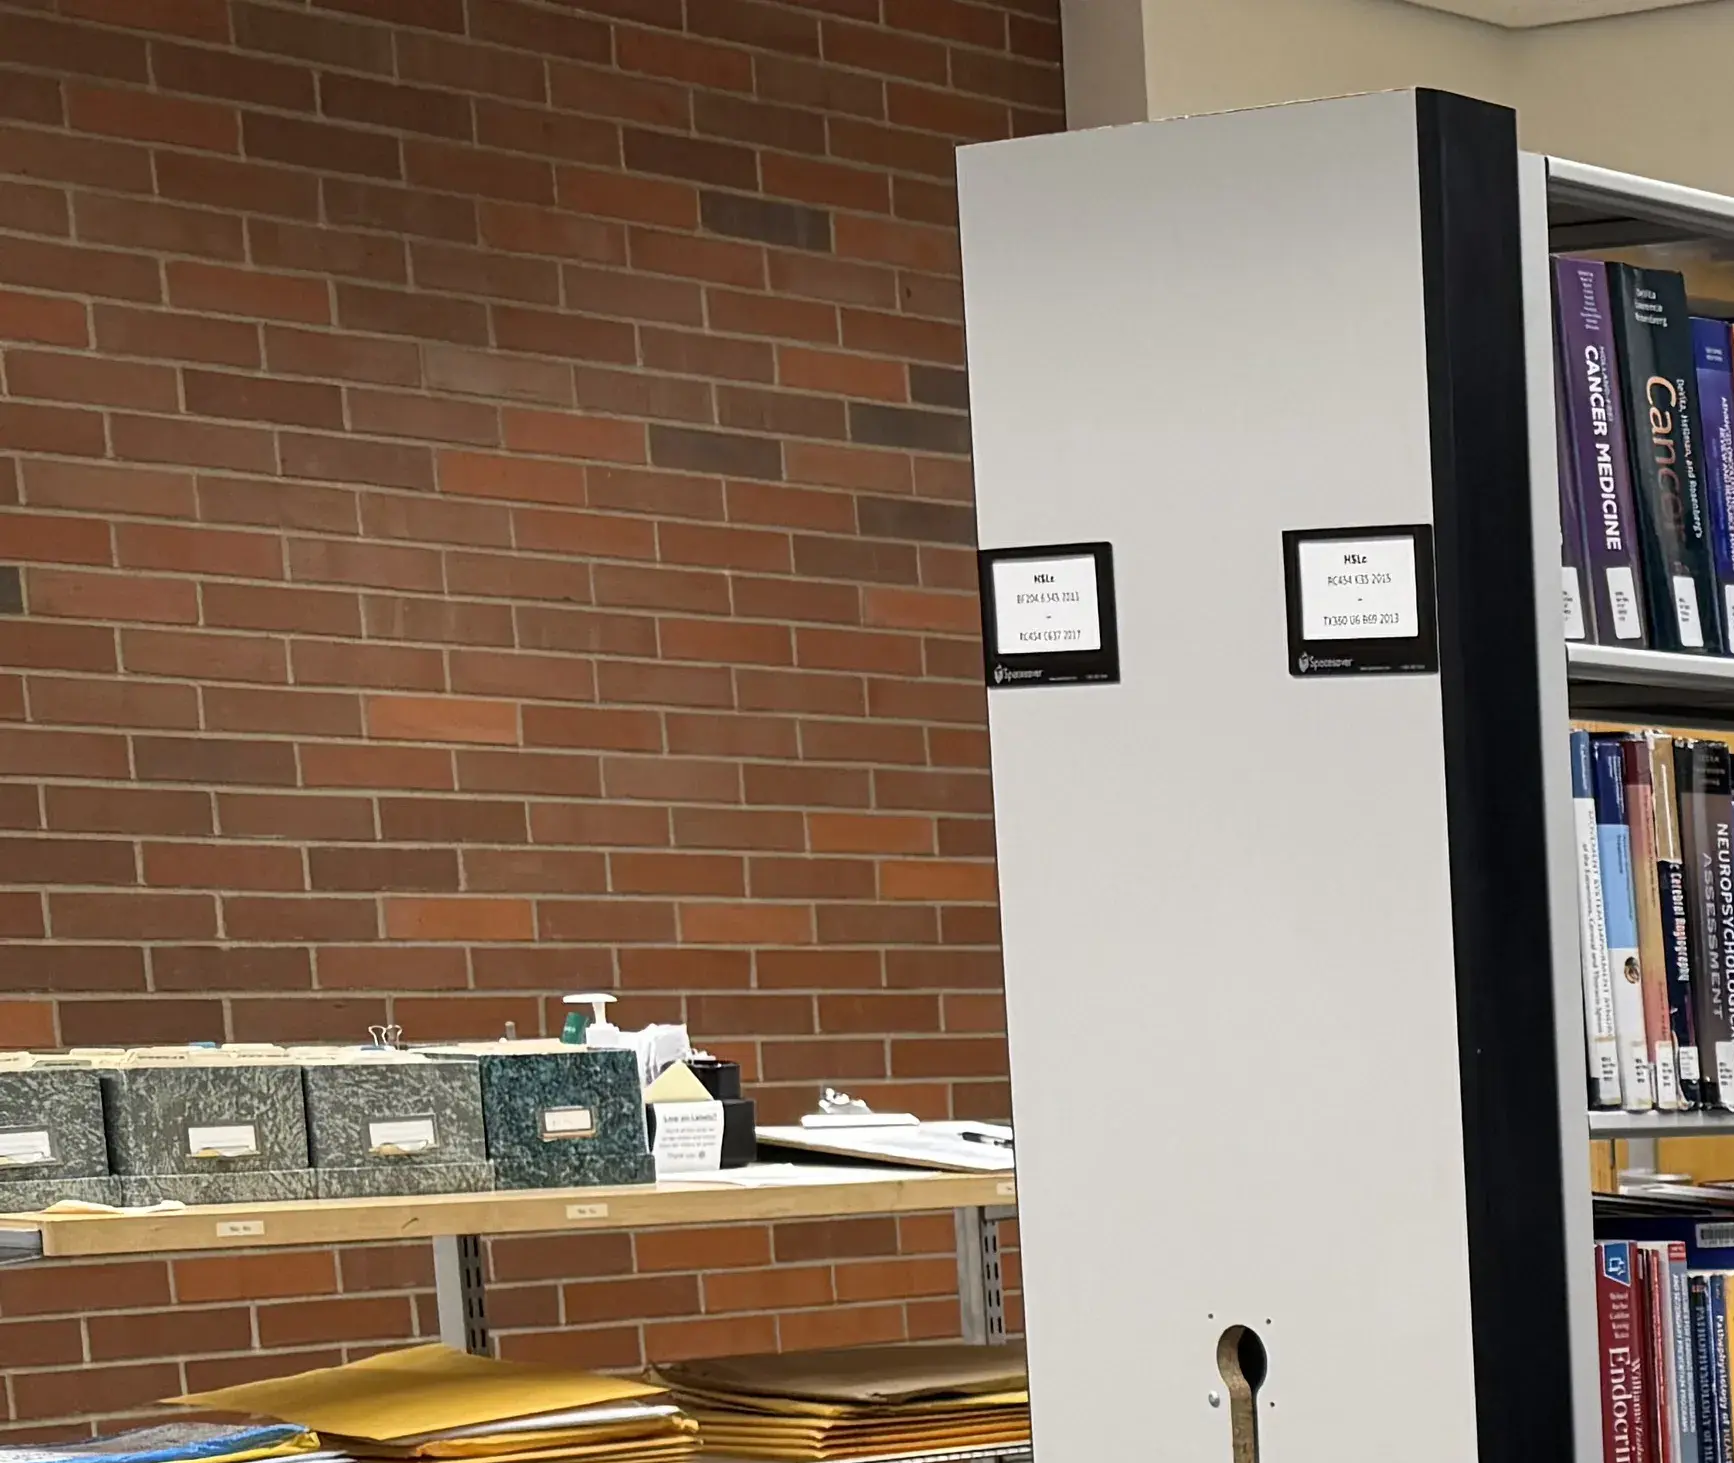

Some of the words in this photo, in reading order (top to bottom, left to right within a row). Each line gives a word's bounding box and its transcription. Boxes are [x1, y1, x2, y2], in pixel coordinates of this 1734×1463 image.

[1584, 345, 1607, 435] CANCER
[1595, 444, 1622, 550] MEDICINE
[1646, 375, 1688, 543] Cancer
[1702, 853, 1723, 1021] ASSESSMENT
[1631, 1357, 1643, 1424] Williams
